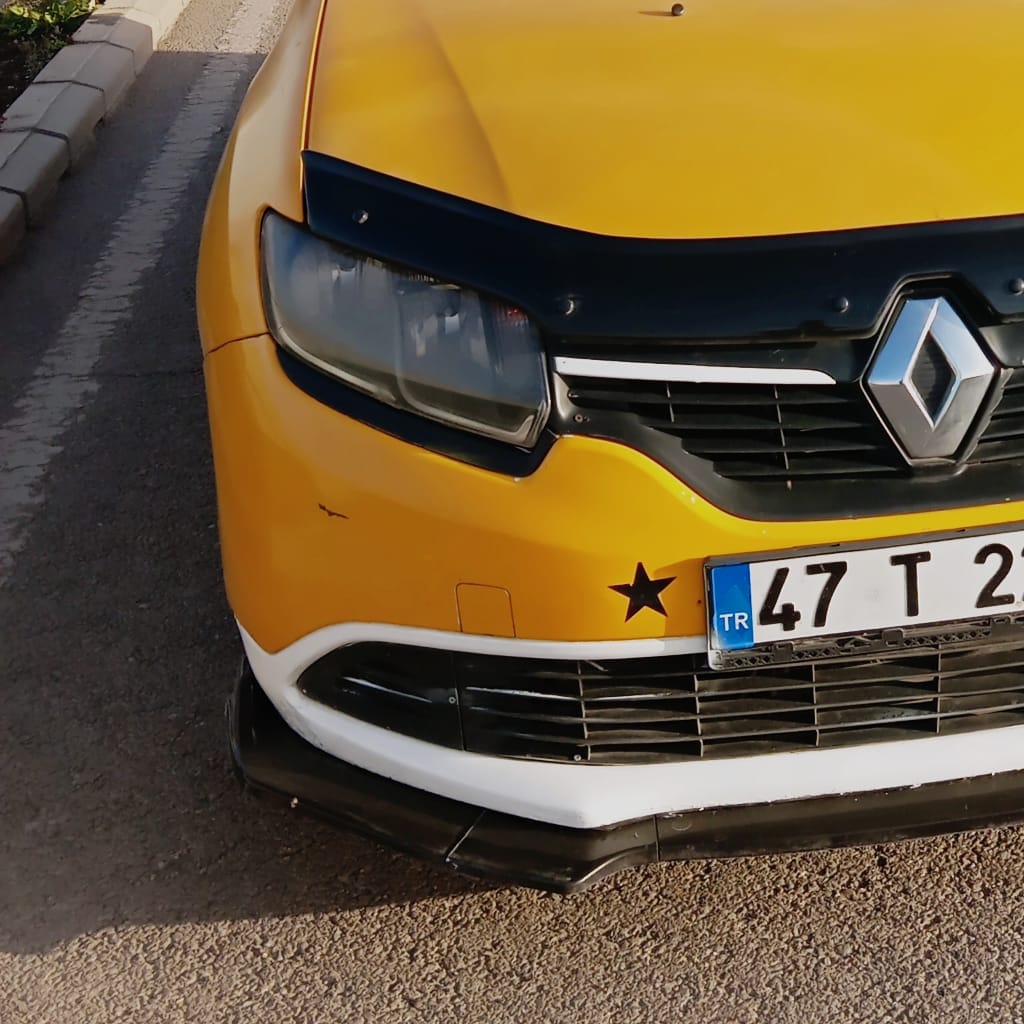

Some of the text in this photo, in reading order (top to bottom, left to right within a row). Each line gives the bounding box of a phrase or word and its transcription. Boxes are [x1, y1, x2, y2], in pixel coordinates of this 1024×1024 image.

[719, 611, 750, 632] TR
[758, 560, 848, 632] 47
[890, 550, 932, 618] T
